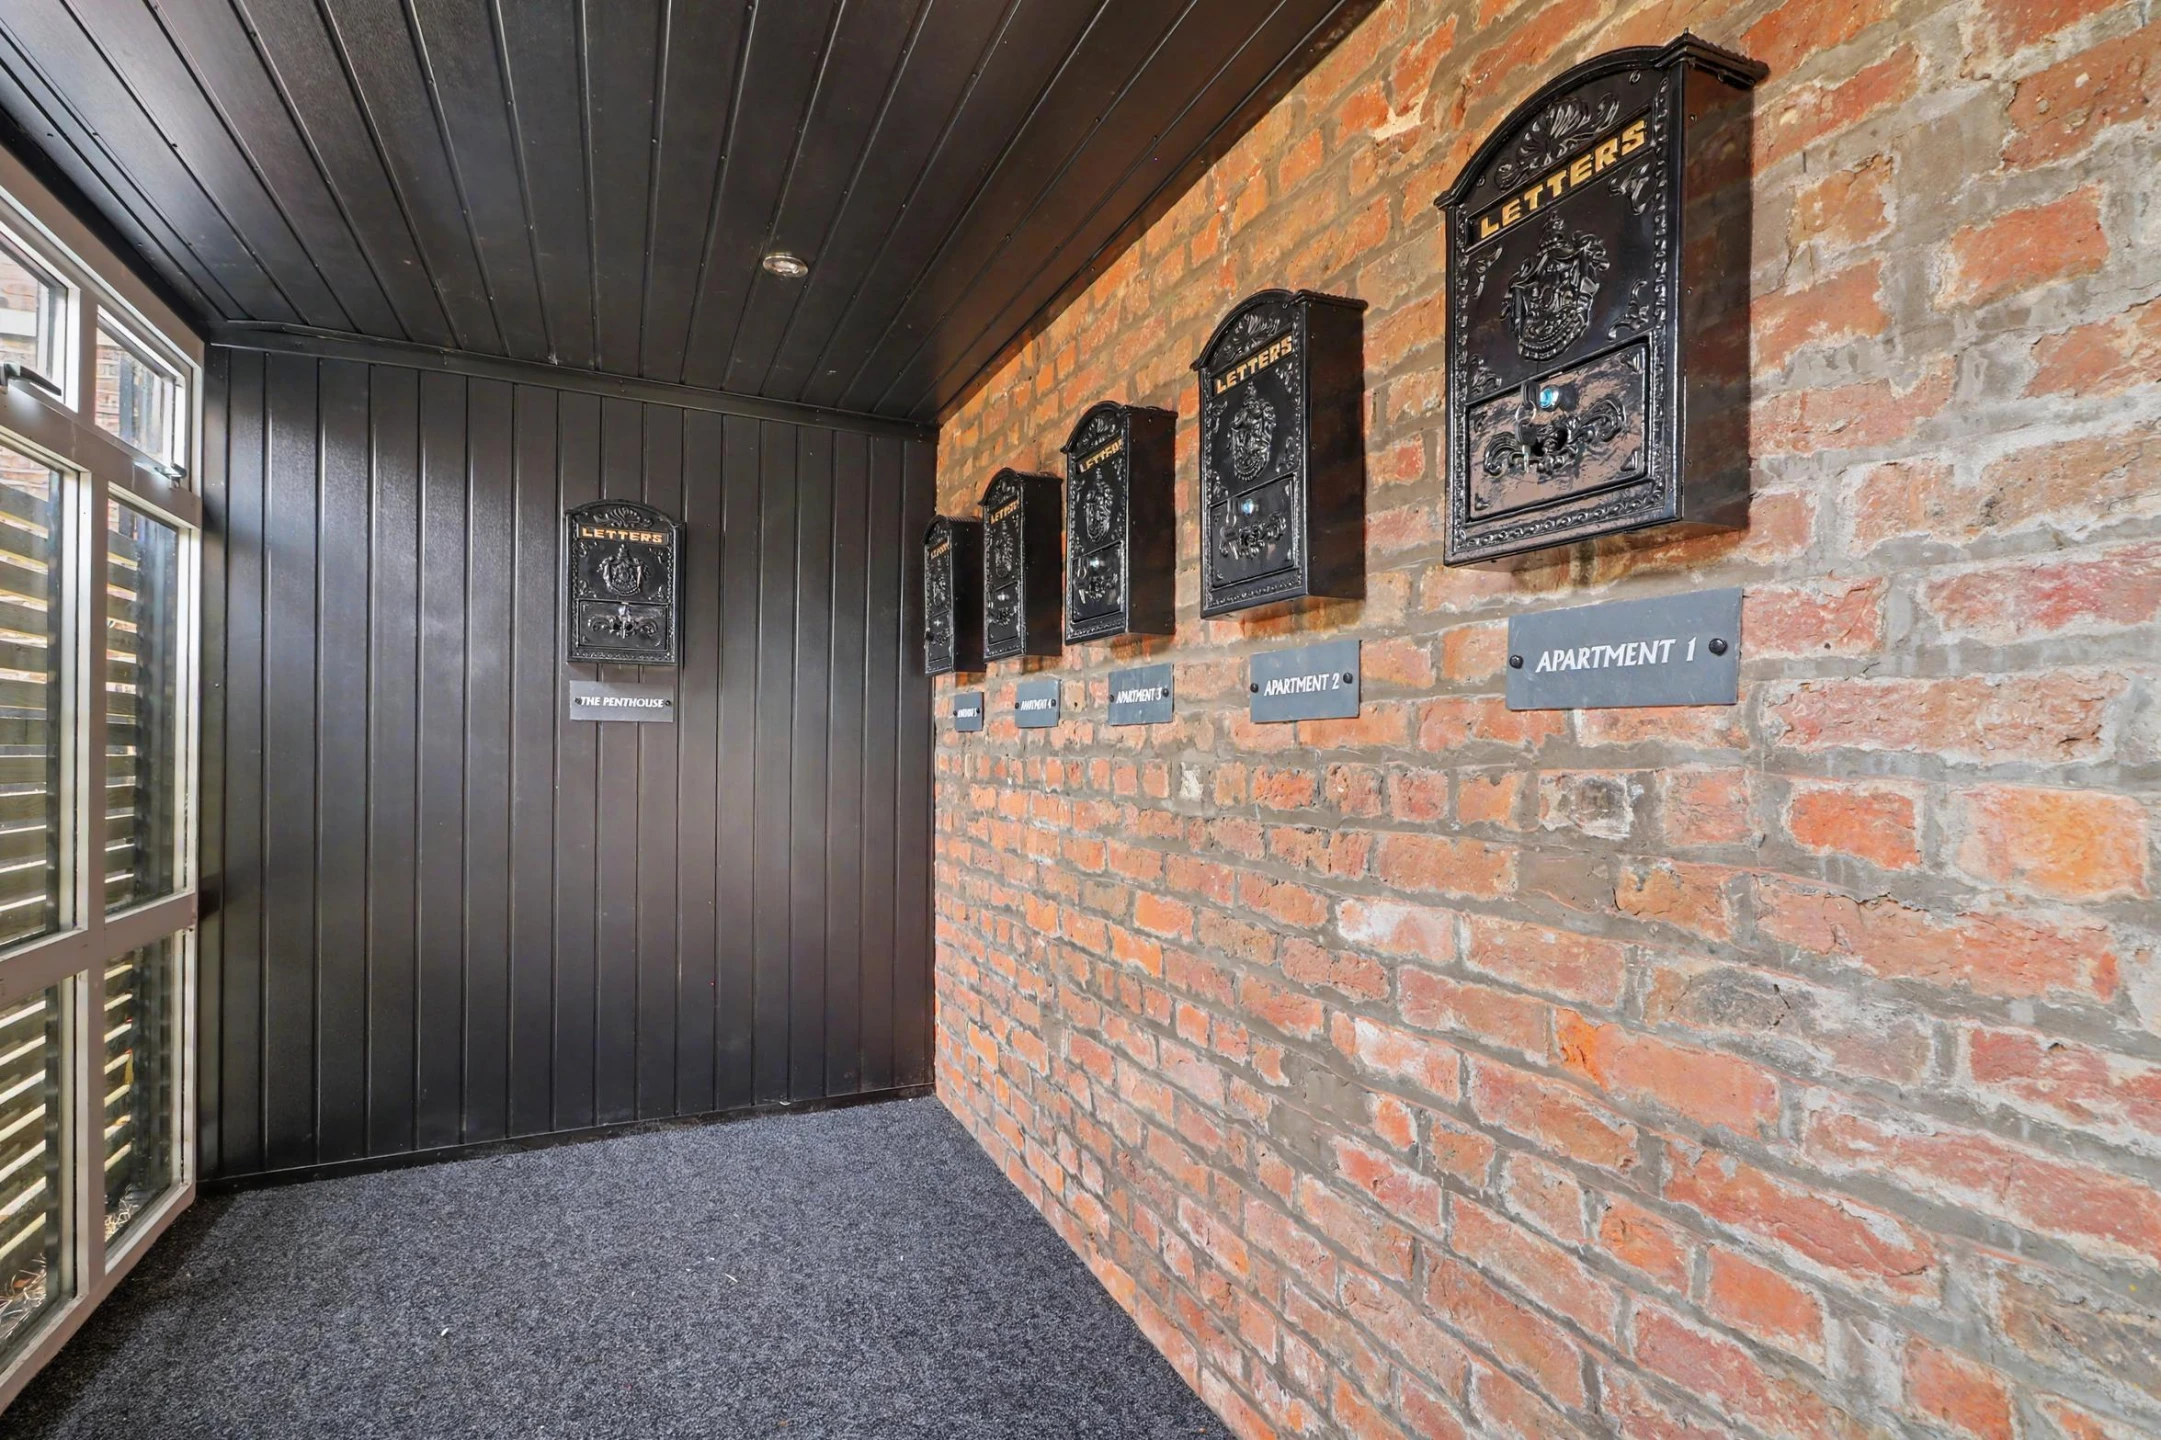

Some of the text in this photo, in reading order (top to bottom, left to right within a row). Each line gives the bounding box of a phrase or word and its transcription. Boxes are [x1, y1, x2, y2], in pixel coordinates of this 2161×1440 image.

[1480, 119, 1646, 239] LETTERS
[1215, 335, 1293, 394] LETTERS
[581, 527, 663, 543] LETTERS
[1535, 636, 1698, 673] APARTMENT 1
[1115, 686, 1163, 704] APARTMENT 3
[1263, 672, 1340, 697] APARTMENT 2
[580, 696, 665, 708] THE PENTHOUSE
